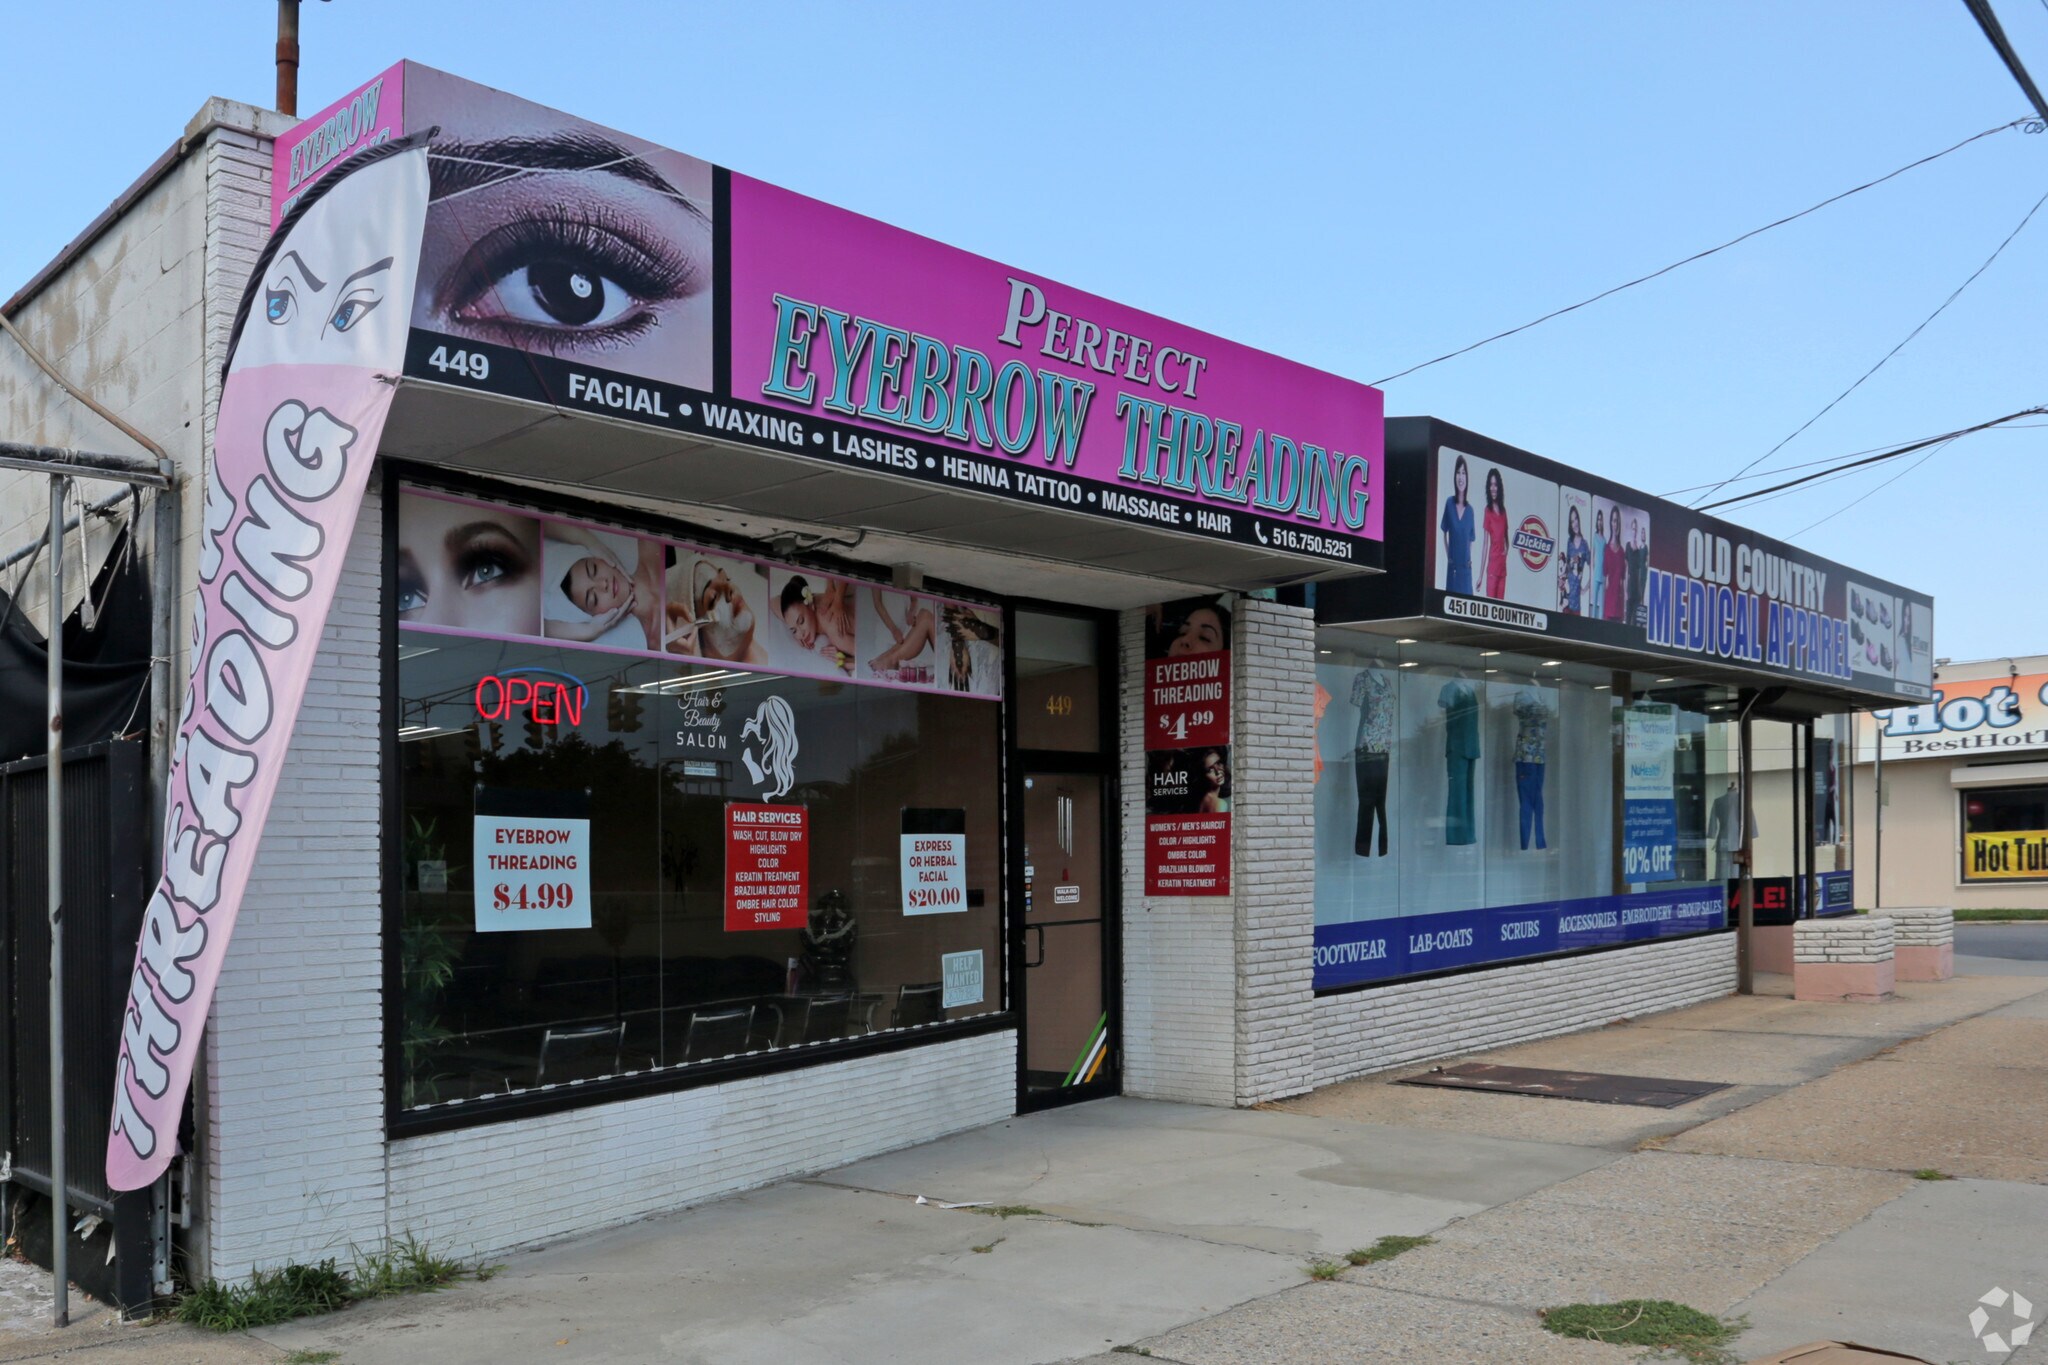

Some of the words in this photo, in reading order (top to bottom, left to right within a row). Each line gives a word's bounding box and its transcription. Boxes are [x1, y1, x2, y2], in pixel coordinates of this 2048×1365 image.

[288, 78, 383, 192] EYEBROW
[998, 277, 1207, 398] PERFECT
[428, 346, 489, 380] 449
[761, 293, 1095, 466] EYEBROW
[1116, 392, 1369, 529] THREADING
[568, 373, 669, 418] FACIAL
[702, 402, 803, 446] WAXING
[833, 431, 918, 470] LASHES
[943, 456, 1010, 490] HENNA
[1015, 471, 1081, 504] TATTOO
[1102, 491, 1180, 524] MASSAGE
[1197, 510, 1231, 534] HAIR
[1273, 527, 1352, 559] 516.750.5251
[1515, 532, 1553, 554] Dickies
[1687, 528, 1731, 585] OLD
[1736, 543, 1827, 612] COUNTRY
[1448, 599, 1467, 615] 451
[1470, 602, 1488, 618] OLD
[1491, 606, 1535, 626] COUNTRY
[1647, 567, 1762, 663] MEDICAL
[1766, 600, 1852, 680] APPAREL
[1156, 658, 1220, 684] EYEBROW
[475, 675, 582, 726] OPEN
[677, 689, 710, 709] Hair
[711, 692, 723, 708] &
[1153, 682, 1222, 706] THREADING
[1046, 694, 1072, 716] 449
[1872, 686, 2022, 737] Hot
[684, 709, 721, 732] Beauty
[1160, 711, 1214, 740] $4.99
[677, 731, 726, 749] SALON
[112, 398, 359, 1160] THREADING
[1154, 771, 1188, 786] HAIR
[1153, 787, 1188, 796] SERVICES
[733, 811, 756, 823] HAIR
[758, 811, 802, 824] SERVICES
[1150, 823, 1176, 832] WOMEN'S
[1182, 822, 1200, 831] MEN'S
[1201, 820, 1226, 830] HAIRCUT
[494, 828, 571, 845] EYEBROW
[733, 830, 754, 842] WASH,
[755, 830, 769, 842] CUT,
[770, 831, 788, 841] BLOW
[790, 831, 802, 842] DRY
[914, 840, 952, 852] EXPRESS
[1159, 837, 1177, 846] COLOR
[1182, 836, 1216, 845] HIGHLIGHTS
[750, 845, 787, 855] HIGHLIGHTS
[1167, 850, 1187, 860] OMBRE
[1188, 850, 1207, 859] COLOR
[1623, 845, 1651, 875] 10%
[1652, 845, 1672, 872] OFF
[1974, 839, 2010, 873] Hot
[488, 855, 578, 871] THREADING
[757, 858, 779, 868] COLOR
[909, 856, 921, 868] OR
[923, 855, 957, 867] HERBAL
[1159, 865, 1187, 874] BRAZILIAN
[1188, 864, 1216, 873] BLOWOUT
[735, 872, 762, 882] KERATIN
[764, 871, 800, 882] TREATMENT
[919, 871, 948, 883] FACIAL
[1158, 879, 1181, 888] KERATIN
[1183, 878, 1216, 887] TREATMENT
[493, 882, 574, 911] $4.99
[734, 885, 767, 896] BRAZILIAN
[769, 885, 787, 895] BLOW
[788, 885, 800, 894] OUT
[909, 887, 960, 908] $20.00
[736, 899, 759, 909] OMBRE
[761, 899, 776, 909] HAIR
[778, 898, 798, 908] COLOR
[755, 912, 780, 923] STYLING
[1312, 939, 1386, 967] FOOTWEAR
[1409, 928, 1473, 954] LAB-COATS
[1501, 920, 1540, 941] SCRUBS
[1559, 911, 1617, 934] ACCESSORIES
[1621, 905, 1672, 925] EMBROIDERY
[1676, 902, 1700, 919] GROUP
[1701, 899, 1722, 915] SALES
[953, 956, 973, 972] HELP
[946, 970, 979, 988] WANTED
